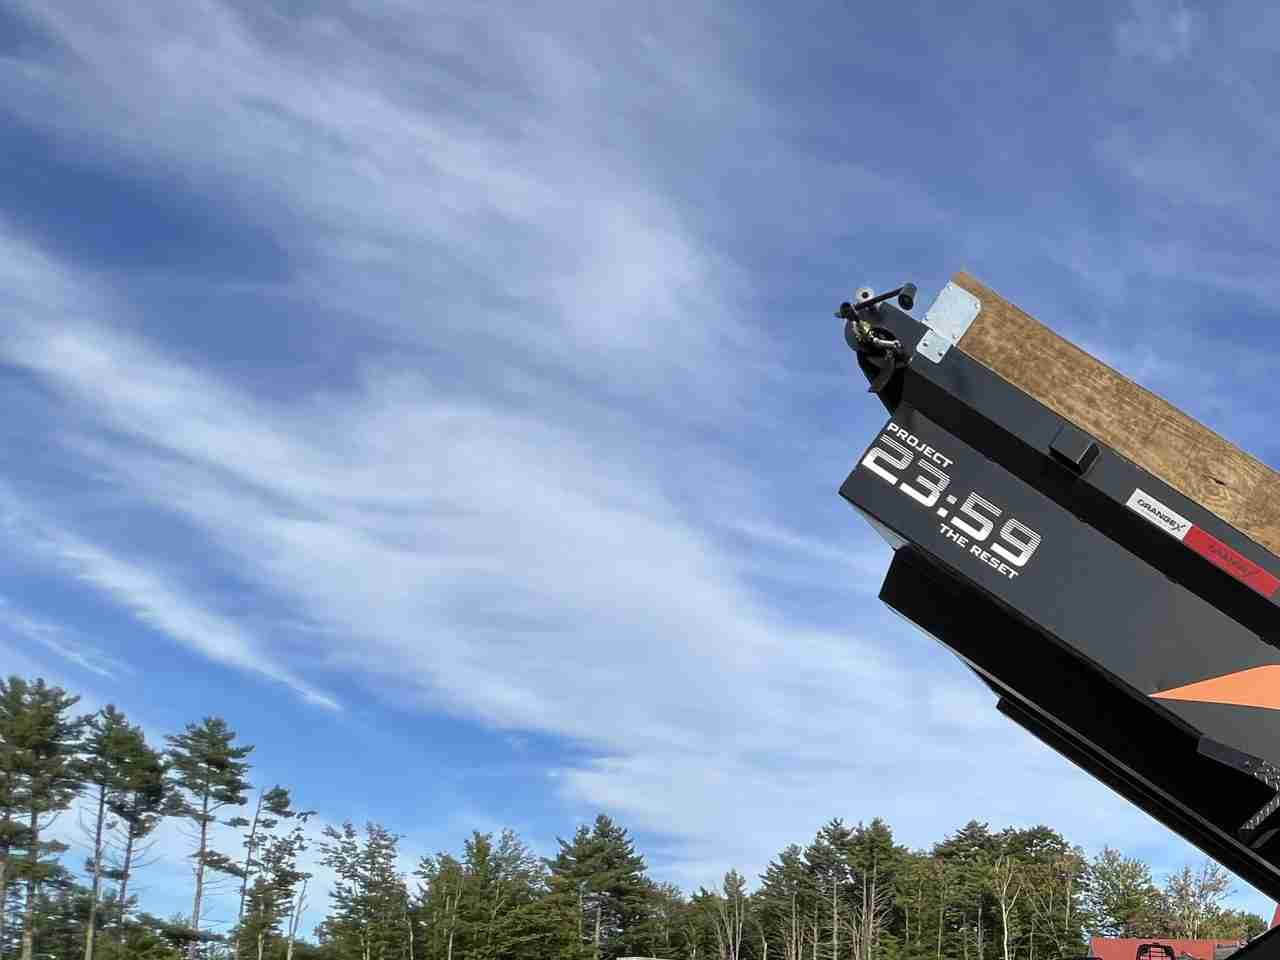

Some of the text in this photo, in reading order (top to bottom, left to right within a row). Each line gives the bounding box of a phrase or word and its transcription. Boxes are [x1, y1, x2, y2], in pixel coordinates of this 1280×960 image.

[887, 422, 954, 468] PROJECT
[861, 433, 1041, 568] 23:59
[938, 523, 1019, 580] THE RESET
